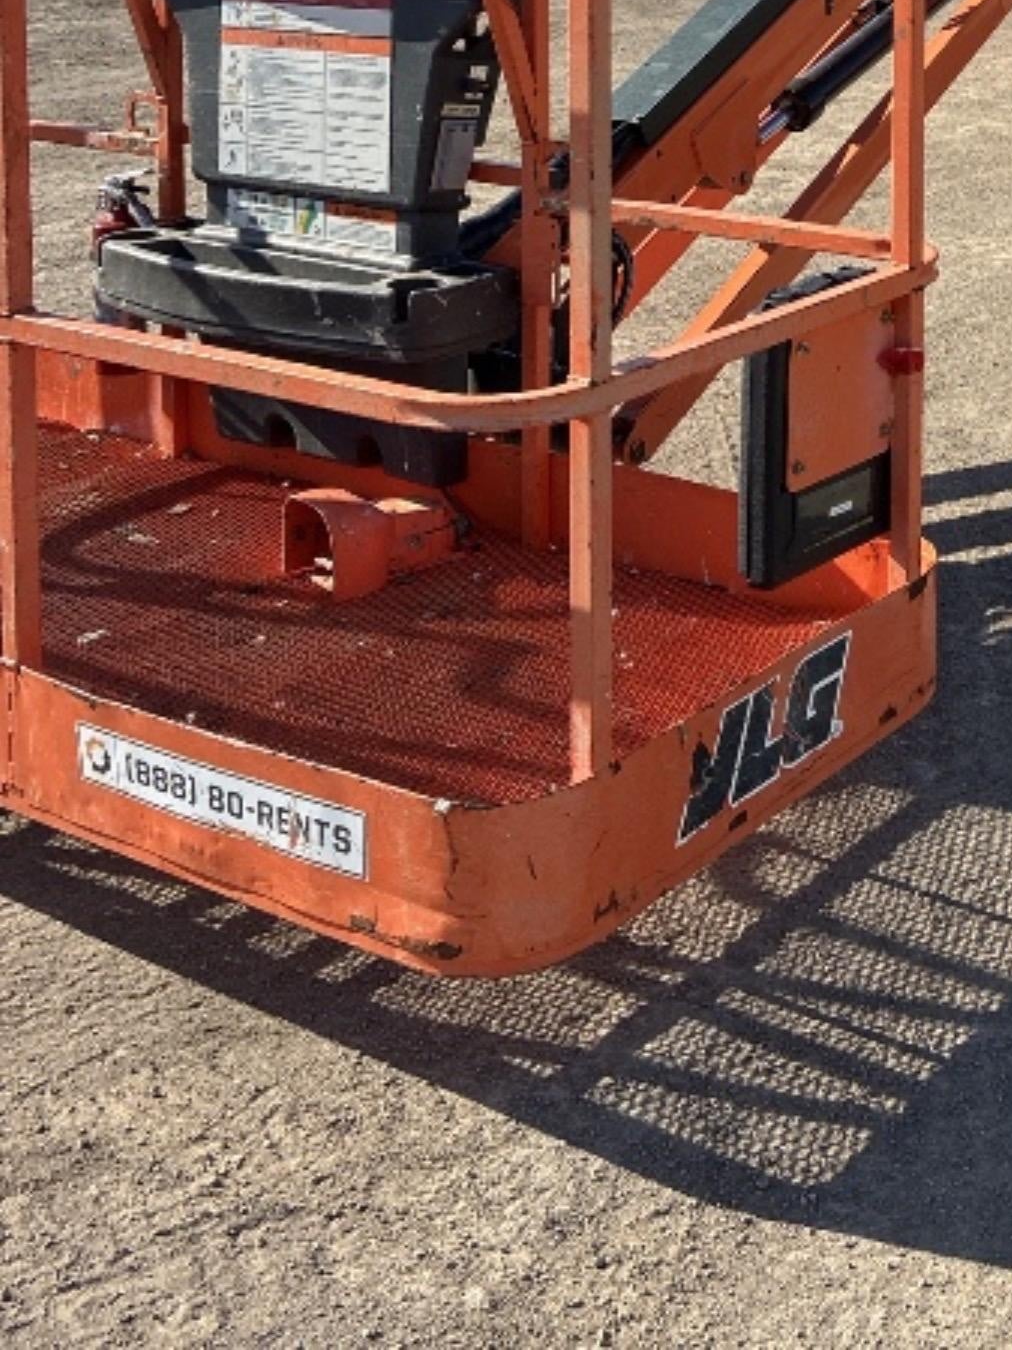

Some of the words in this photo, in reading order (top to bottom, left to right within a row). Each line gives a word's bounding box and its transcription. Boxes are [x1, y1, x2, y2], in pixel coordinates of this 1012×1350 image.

[124, 752, 196, 806] (888)
[208, 784, 352, 855] 80-RENTS
[675, 630, 852, 849] JLG
